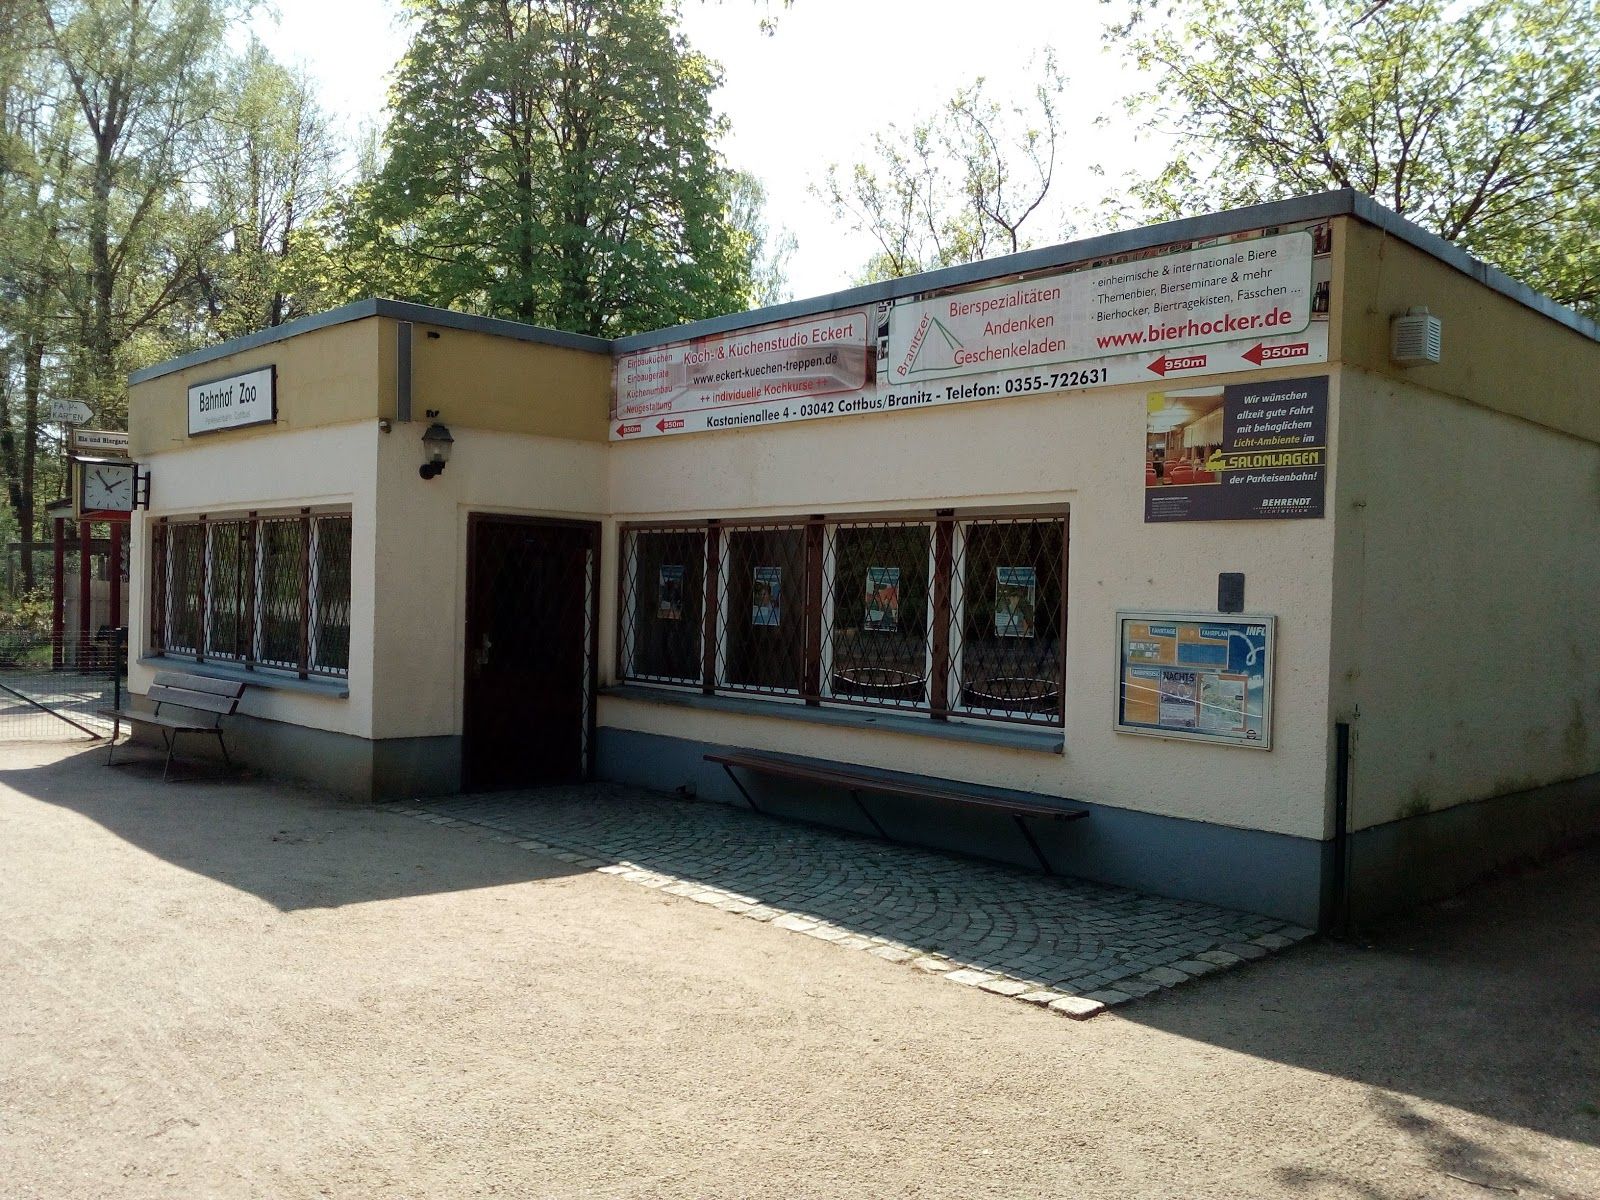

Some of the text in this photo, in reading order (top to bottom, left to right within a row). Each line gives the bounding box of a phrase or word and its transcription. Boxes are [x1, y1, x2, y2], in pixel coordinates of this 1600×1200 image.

[1098, 248, 1277, 287] einheimische & internationale Biere
[1098, 267, 1273, 305] Themenbier, Bierseminare & mehr
[950, 287, 1061, 318] Bierspezialitäten
[1096, 306, 1150, 322] Bierhocker,
[1153, 292, 1234, 313] Biertragekisten,
[1237, 284, 1287, 300] Fässchen
[983, 314, 1054, 337] Andenken
[1096, 307, 1292, 349] www.bierhocker.de
[683, 323, 853, 365] Koch- & Küchenstudio Eckert
[897, 312, 929, 377] Branitzer
[953, 337, 1066, 366] Geschenkeladen
[1261, 344, 1308, 359] 950m
[627, 354, 673, 369] Einbauküchen
[693, 353, 838, 385] www.eckert-kuechen-treppen.de
[1164, 357, 1206, 370] 950m
[627, 370, 669, 384] Einbaugeräte
[199, 382, 257, 412] Bahnhof Zoo
[626, 386, 673, 399] Küchenumbau
[706, 410, 780, 428] Kastanienallee
[783, 407, 790, 419] 4
[800, 402, 834, 417] 03042
[838, 391, 932, 412] Cottbus/Branitz
[946, 384, 1000, 401] Telefon:
[1005, 367, 1107, 393] 0355-722631
[712, 387, 762, 403] individuelle
[764, 380, 814, 396] Kochkurse
[1244, 391, 1307, 404] Wir wünschen
[626, 401, 672, 414] Neugestaltung
[1236, 405, 1314, 420] allzeit gute Fahrt
[1236, 420, 1312, 433] mit behaglichem
[1233, 434, 1315, 447] Licht-Ambiente im
[1230, 452, 1319, 468] SALONWAGEN
[1229, 472, 1318, 484] der Parkeisenbahn!
[1262, 498, 1312, 507] BEHRENDT
[1162, 671, 1196, 682] NACHTS
